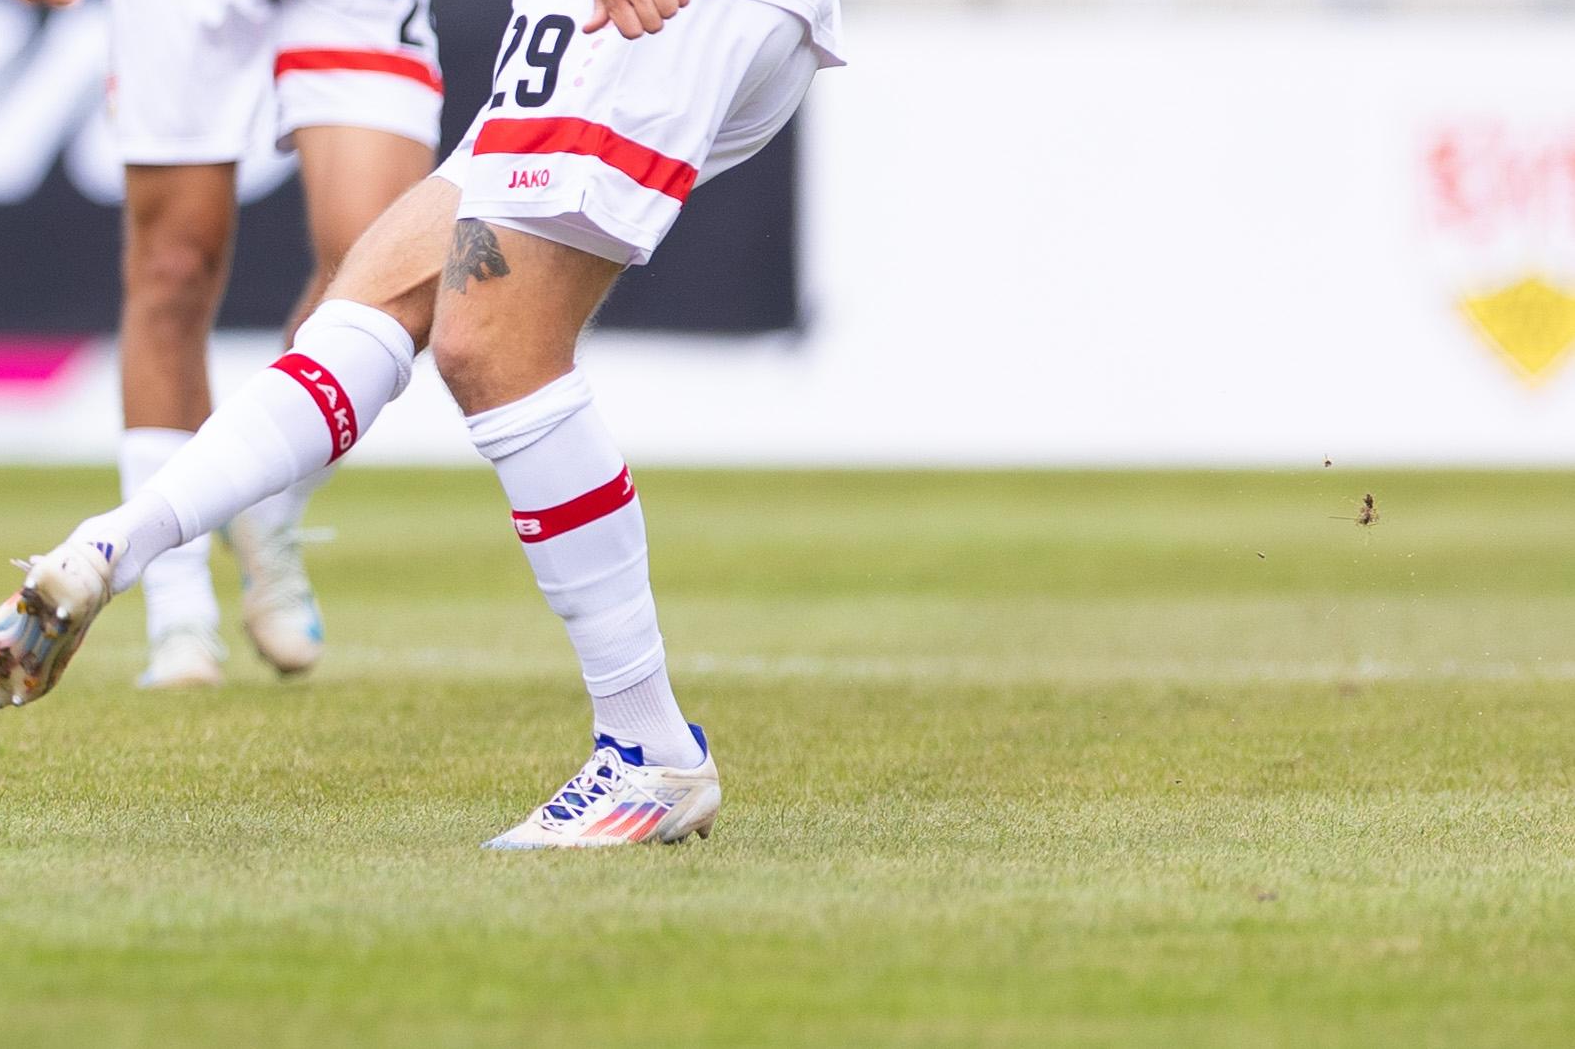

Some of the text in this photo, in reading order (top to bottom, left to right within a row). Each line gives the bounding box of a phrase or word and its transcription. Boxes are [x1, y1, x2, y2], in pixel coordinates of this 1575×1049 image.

[488, 14, 576, 110] 29
[508, 169, 550, 189] JAKO
[300, 367, 353, 451] JAKO
